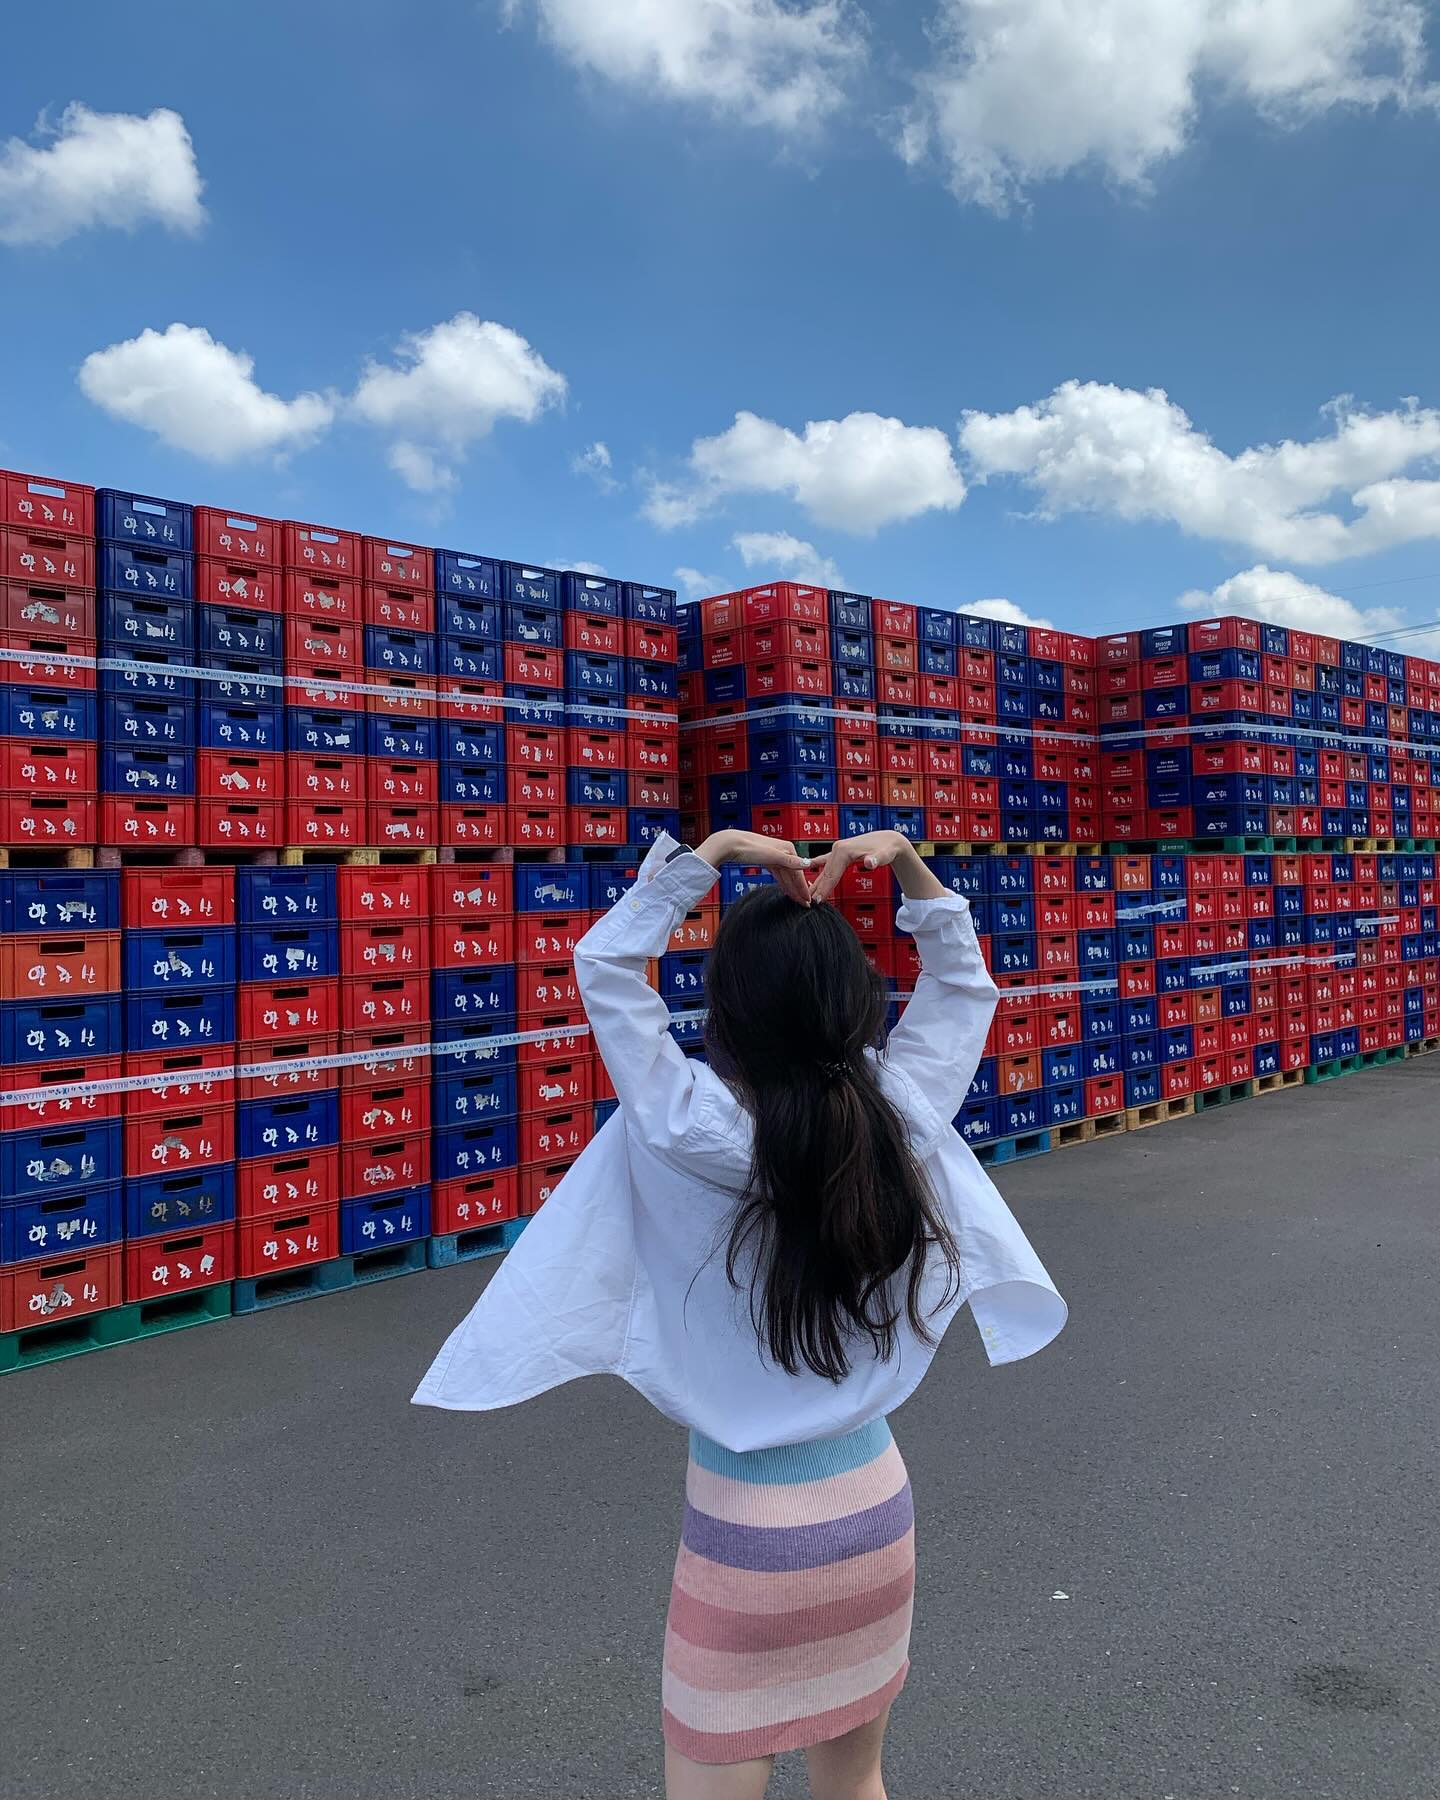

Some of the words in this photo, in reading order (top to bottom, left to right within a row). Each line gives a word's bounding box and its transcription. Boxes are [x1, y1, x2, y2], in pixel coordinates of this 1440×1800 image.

[18, 496, 74, 526] 한라산
[124, 516, 174, 541] 한라산
[220, 533, 265, 557] 한라산
[16, 553, 76, 578] 한라산
[304, 546, 346, 568] 한라산
[125, 567, 175, 590] 한라산
[381, 561, 420, 580] 한산
[452, 573, 488, 593] 한라산
[304, 593, 346, 613] 한산
[581, 592, 610, 610] 한라산
[19, 605, 75, 629] 한산
[381, 604, 419, 624] 한라산
[638, 603, 666, 620] 한라산
[453, 614, 488, 633] 한라산
[219, 629, 264, 650] 한라산
[581, 631, 611, 651] 한라산
[383, 649, 421, 668] 한라산
[454, 657, 489, 677] 한라산
[519, 663, 551, 680] 한라산
[582, 668, 612, 686] 한라산
[640, 678, 667, 693] 한라산
[125, 719, 175, 738] 한라산
[220, 724, 266, 743] 한라산
[456, 741, 492, 758] 한라산
[520, 743, 552, 758] 한산
[22, 764, 77, 783] 한라산
[218, 772, 266, 790] 한산
[307, 775, 349, 792] 한라산
[384, 779, 423, 794] 한라산
[456, 783, 491, 798] 한라산
[522, 785, 554, 799] 한라산
[641, 790, 668, 803] 한라산
[125, 819, 176, 836] 한라산
[219, 820, 265, 837] 한라산
[307, 821, 349, 837] 한라산
[457, 823, 492, 837] 한라산
[522, 824, 554, 838] 한라산
[152, 898, 212, 918] 한라산
[263, 896, 317, 914] 한라산
[361, 892, 410, 910] 한라산
[454, 940, 497, 957] 한라산
[536, 937, 576, 954] 한라산
[28, 964, 95, 986] 한라산
[676, 973, 704, 988] 한라
[455, 993, 499, 1011] 한라산
[537, 985, 575, 1002] 한라산
[362, 998, 411, 1018] 한라산
[152, 1018, 212, 1040] 한라산
[27, 1028, 95, 1051] 한라산
[363, 1108, 412, 1128] 한라산
[263, 1124, 319, 1147] 한라산
[539, 1131, 579, 1152] 한라산
[152, 1139, 213, 1165] 한라산
[457, 1147, 501, 1169] 한라산
[27, 1154, 95, 1180] 한산
[264, 1180, 319, 1204] 한라산
[151, 1197, 214, 1221] 한라산
[457, 1198, 503, 1220] 한라산
[362, 1216, 413, 1240] 한라산
[263, 1235, 320, 1260] 한라산
